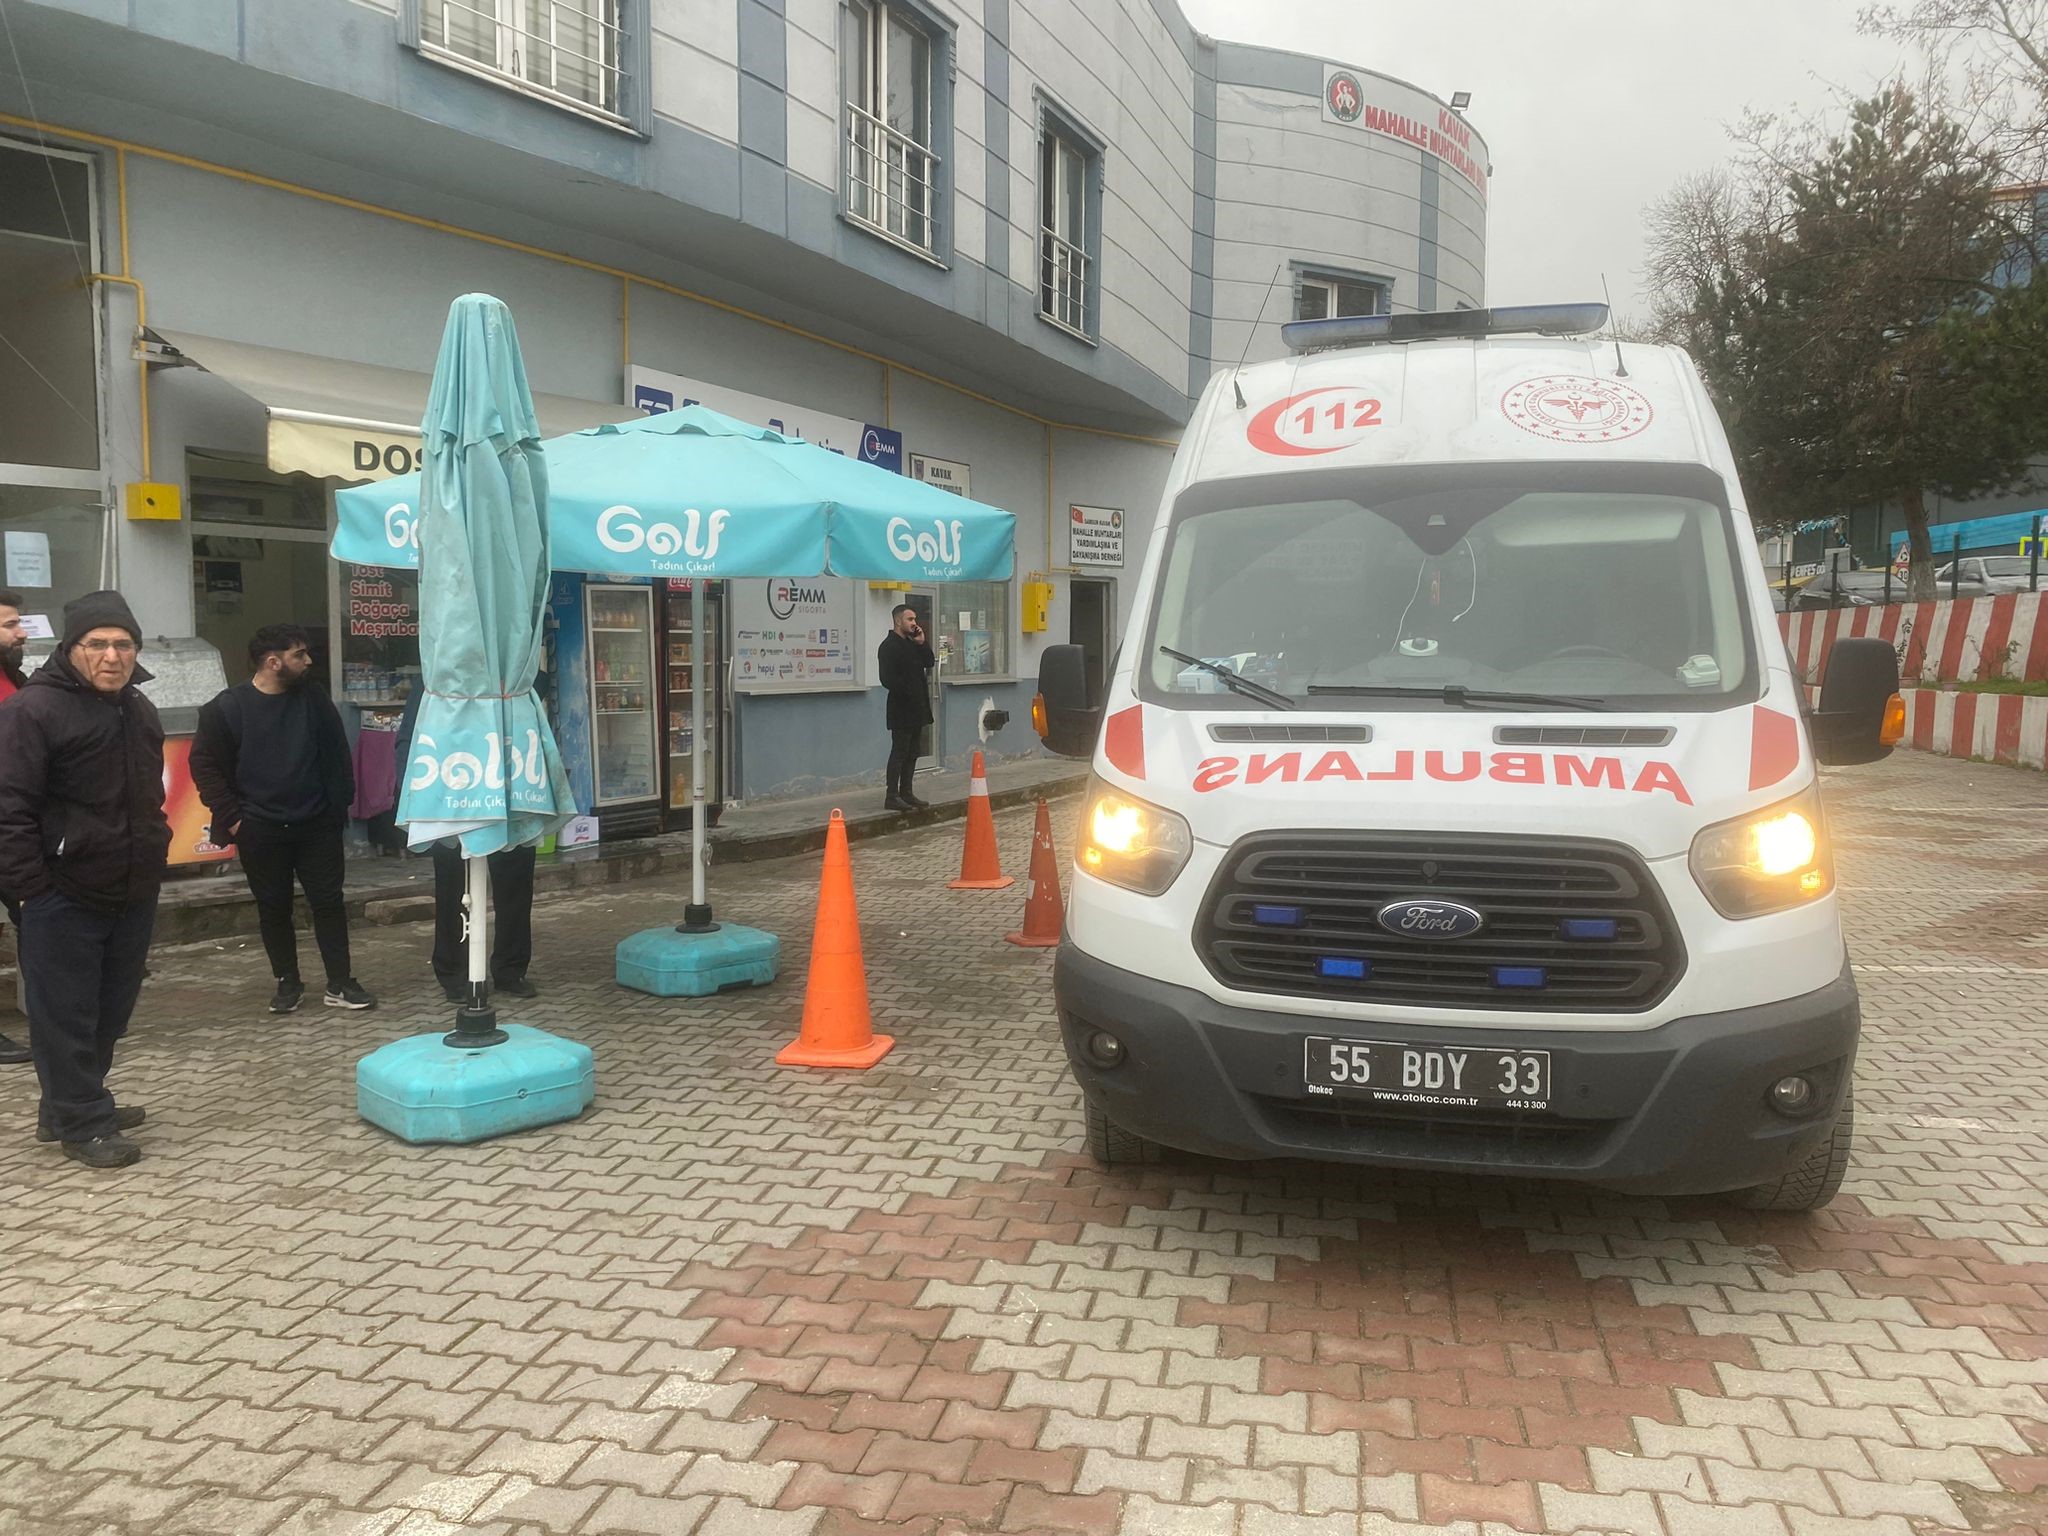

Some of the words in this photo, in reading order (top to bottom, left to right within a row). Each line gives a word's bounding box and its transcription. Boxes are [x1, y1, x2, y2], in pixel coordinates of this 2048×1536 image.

[1365, 104, 1428, 148] MAHALLE
[1438, 107, 1471, 152] KAVAK
[1295, 398, 1382, 434] 112
[869, 439, 895, 454] REMM
[354, 441, 423, 475] DO
[931, 467, 952, 480] KAVAK
[596, 505, 731, 560] Golf
[1073, 528, 1093, 537] MAHALLE
[887, 517, 964, 566] Golf
[1111, 542, 1118, 550] VE
[651, 559, 684, 572] Tadını
[686, 561, 715, 574] Çıkar!
[350, 579, 393, 597] Simit
[778, 587, 827, 604] REMM
[350, 599, 410, 619] Poğaça
[351, 618, 419, 639] Meşruba
[762, 631, 776, 641] HDI
[445, 796, 482, 808] Tadını
[1401, 906, 1458, 931] Ford
[1330, 1044, 1370, 1084] 55
[1403, 1050, 1468, 1090] BDY
[1498, 1056, 1541, 1095] 33
[1308, 1085, 1333, 1096] Otokoç
[1373, 1092, 1479, 1107] www.otokoc.com.tr
[1506, 1100, 1522, 1108] 444
[1523, 1100, 1530, 1108] 3
[1531, 1101, 1547, 1110] 300
